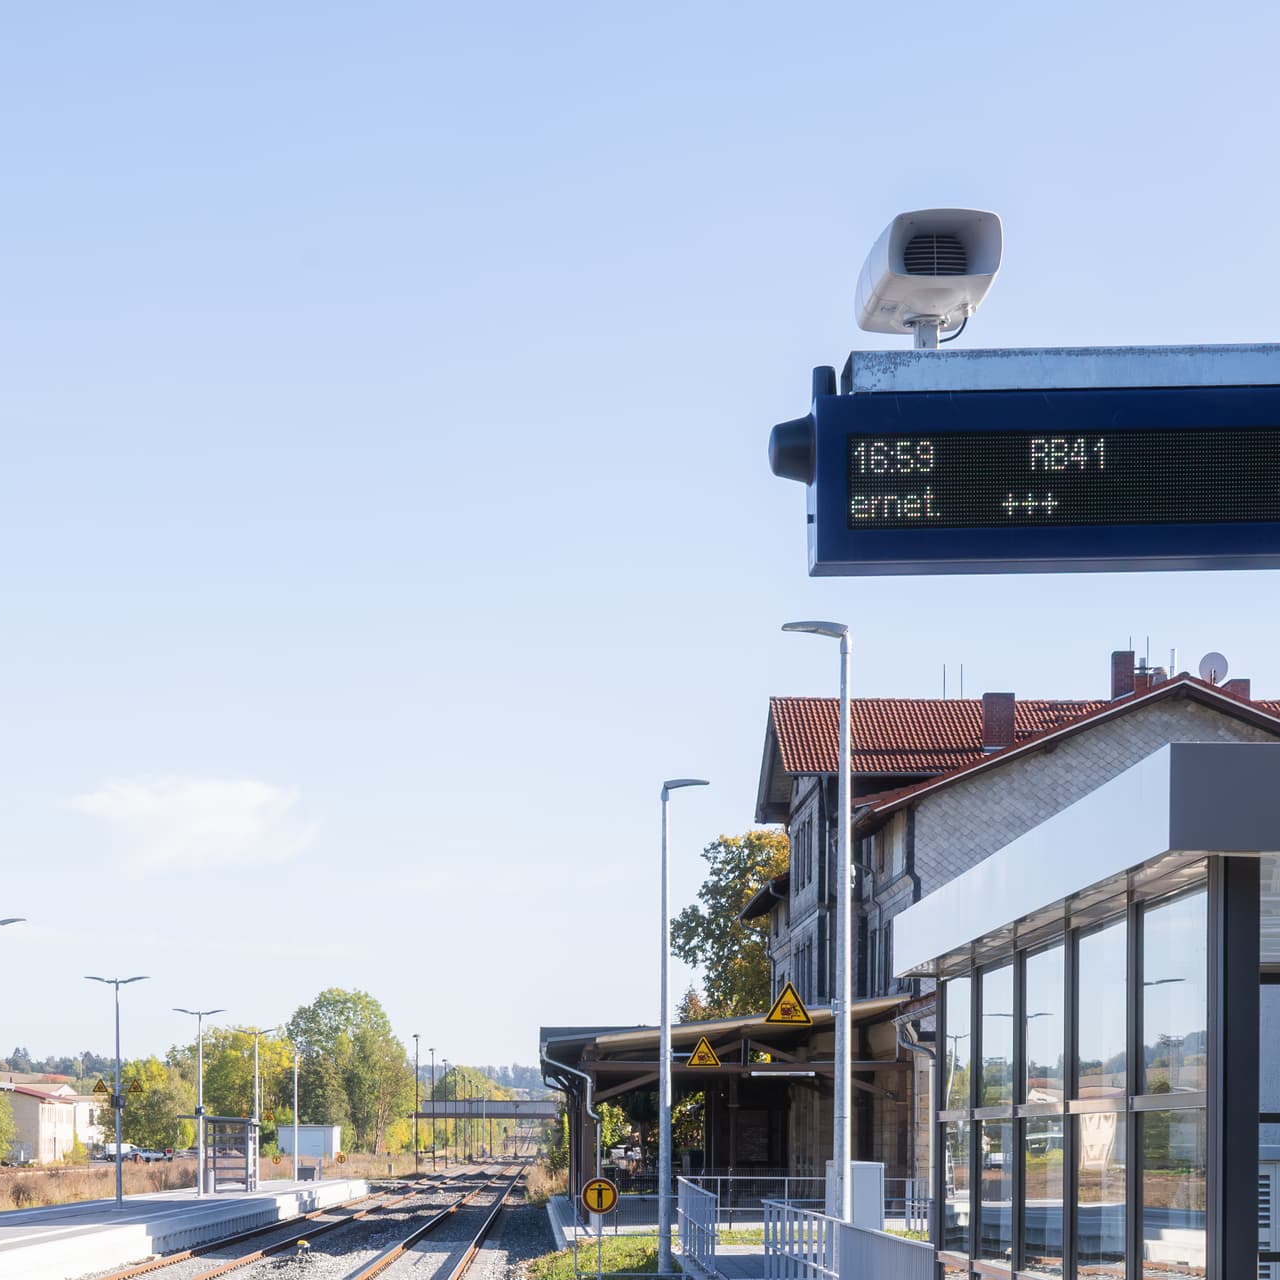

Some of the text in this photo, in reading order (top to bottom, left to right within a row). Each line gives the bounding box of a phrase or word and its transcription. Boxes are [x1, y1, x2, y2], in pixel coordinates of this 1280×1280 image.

[854, 441, 933, 472] 16:59
[1031, 438, 1104, 470] RB41
[851, 486, 940, 517] ernet.
